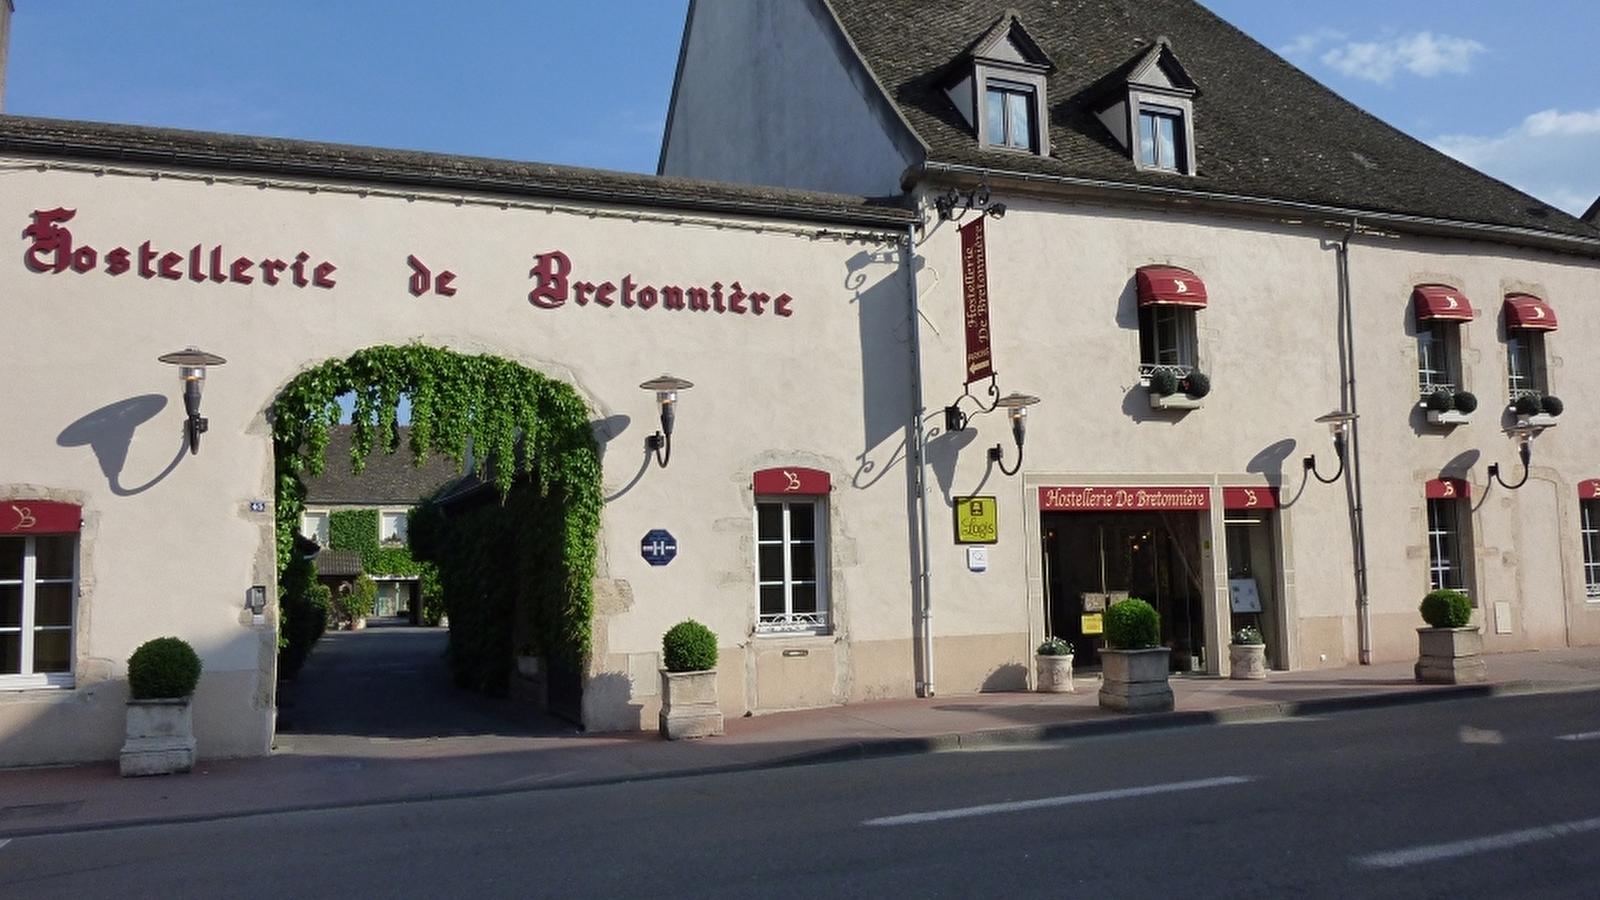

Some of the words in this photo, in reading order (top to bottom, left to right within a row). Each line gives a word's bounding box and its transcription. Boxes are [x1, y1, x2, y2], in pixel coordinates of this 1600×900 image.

[25, 207, 337, 289] Hostellerie
[408, 254, 457, 297] de
[530, 251, 793, 316] Bretonnière
[976, 225, 986, 316] Bretonnière
[965, 247, 977, 328] Hostellerie
[979, 319, 988, 343] De
[1046, 488, 1112, 507] Hostellerie
[1115, 489, 1133, 507] De
[1136, 489, 1204, 507] Bretonnière
[961, 518, 994, 538] Logis
[652, 541, 666, 556] H
